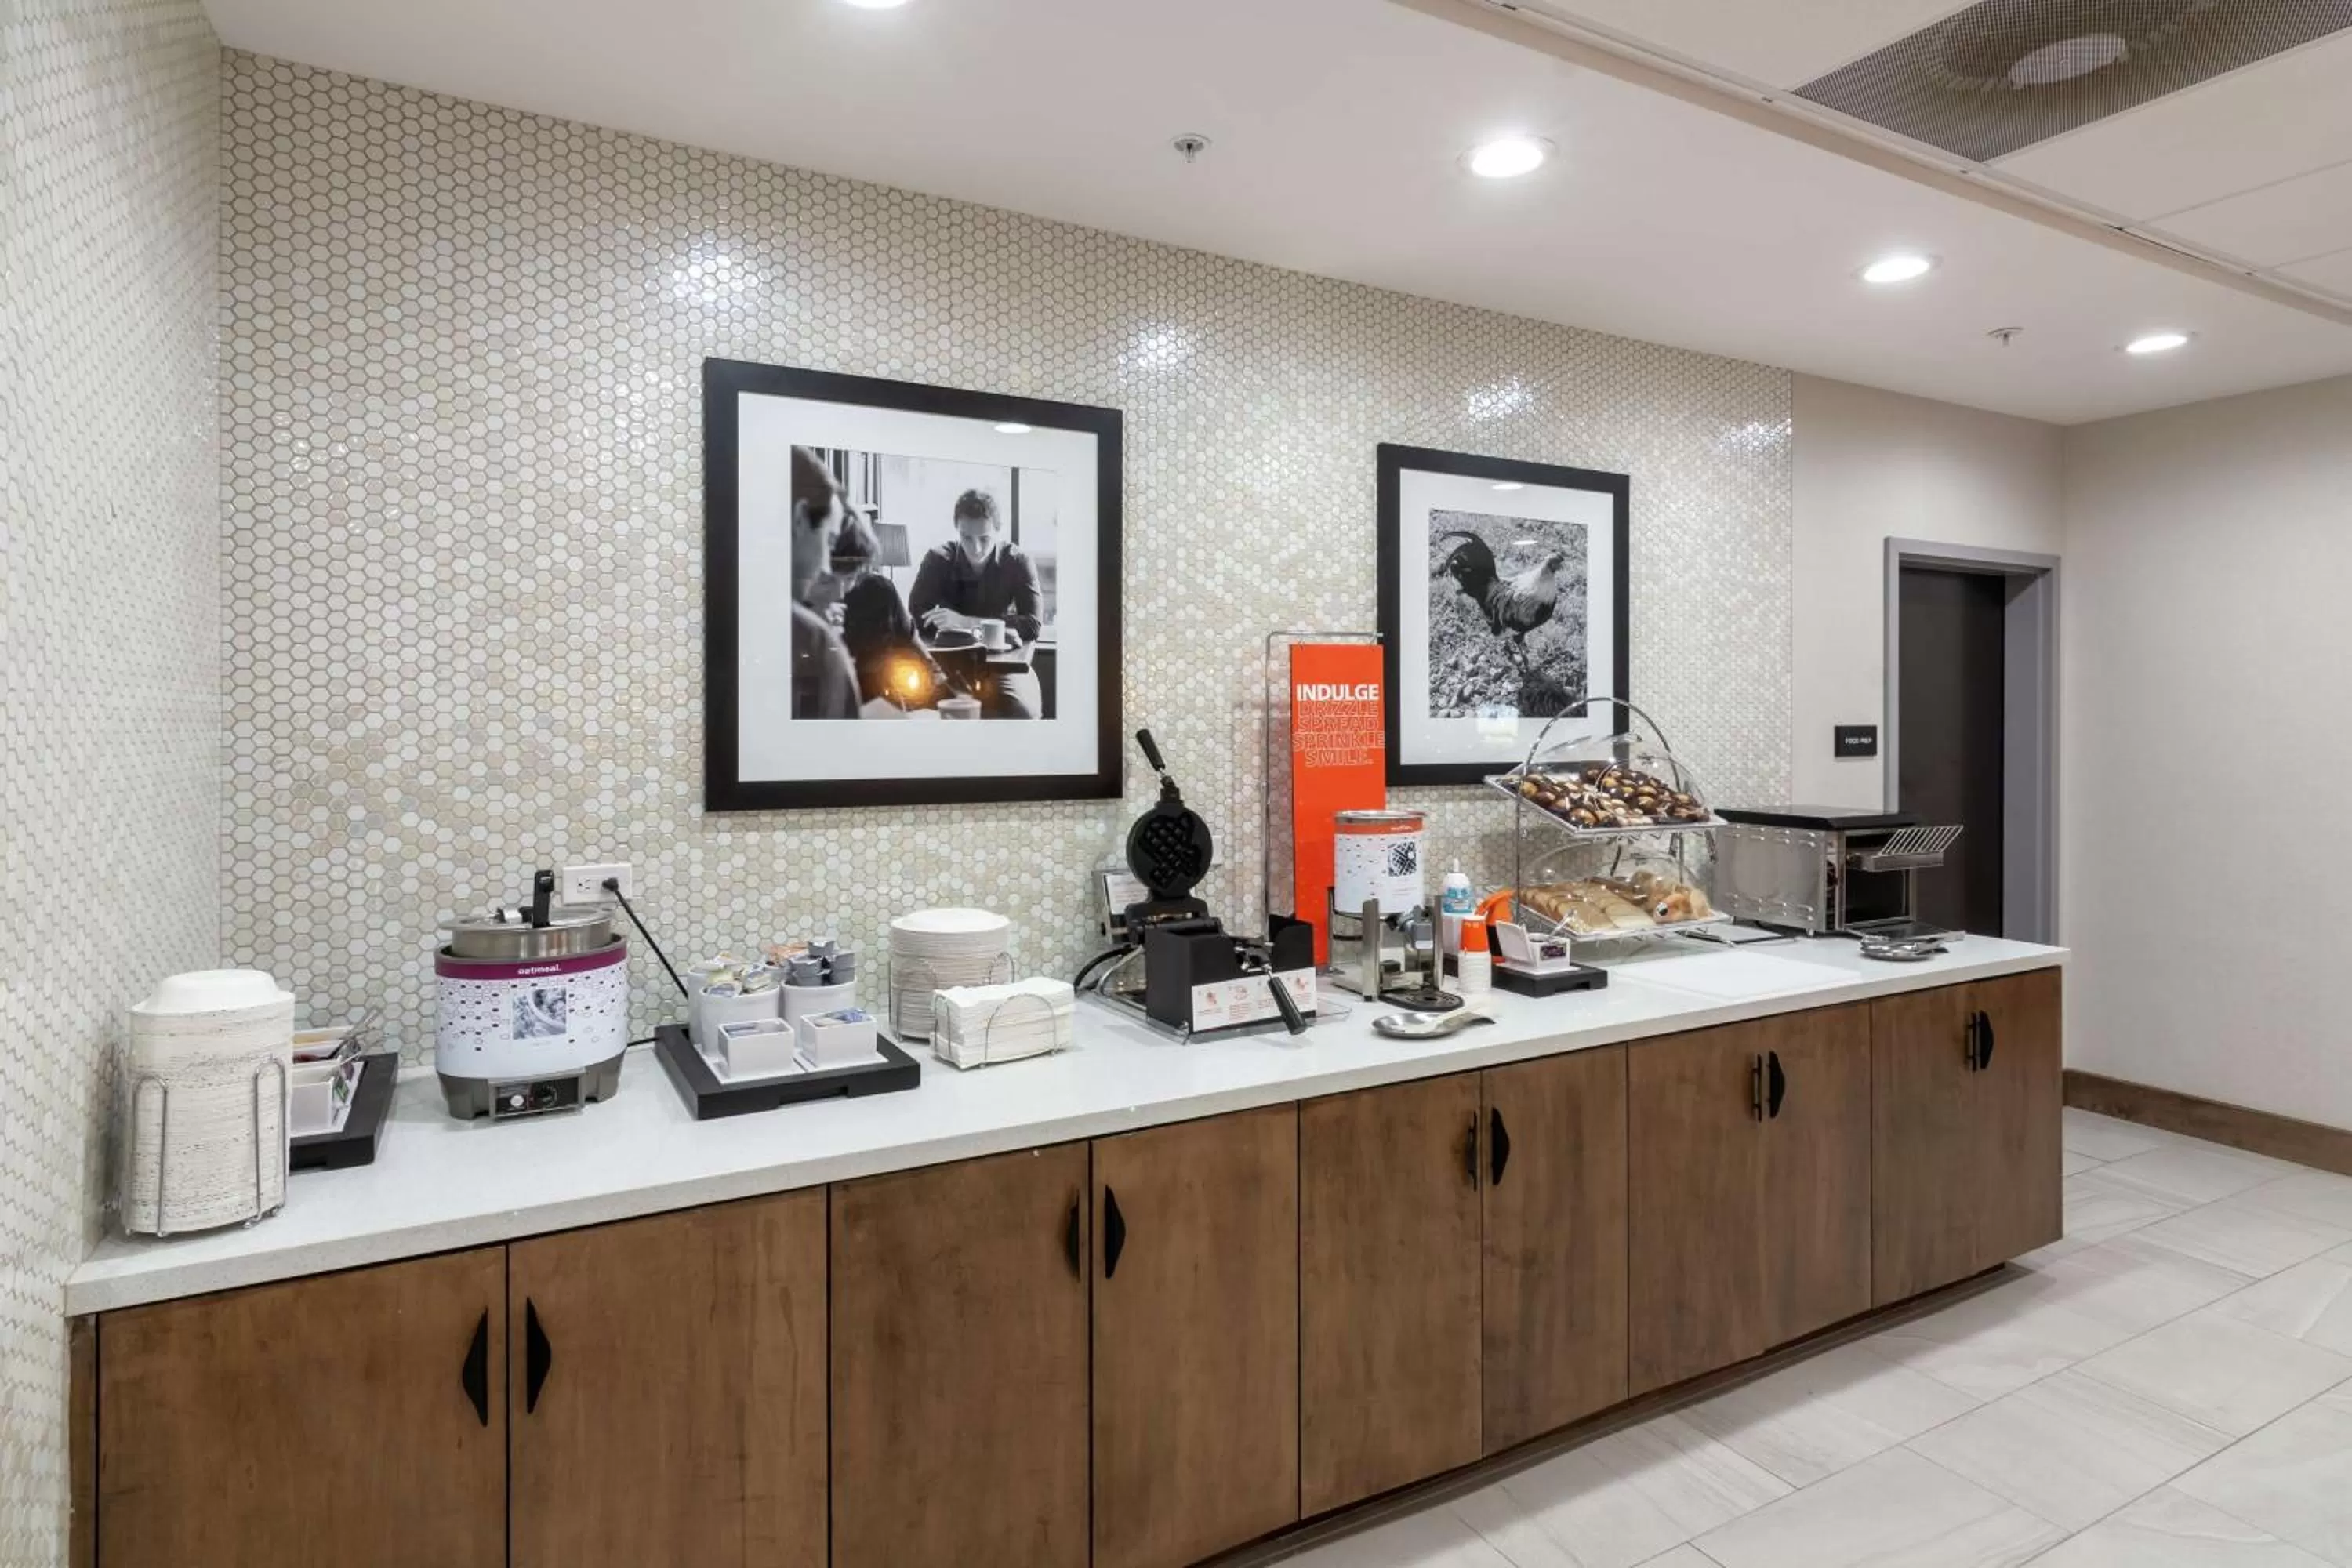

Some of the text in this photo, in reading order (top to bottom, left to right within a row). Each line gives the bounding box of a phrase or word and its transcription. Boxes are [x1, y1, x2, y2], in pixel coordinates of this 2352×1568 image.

[1296, 683, 1380, 701] INDULGE
[1298, 700, 1379, 717] DRIZZLE
[1298, 715, 1379, 732] SPREAD
[1292, 731, 1386, 752] SPRINKLE
